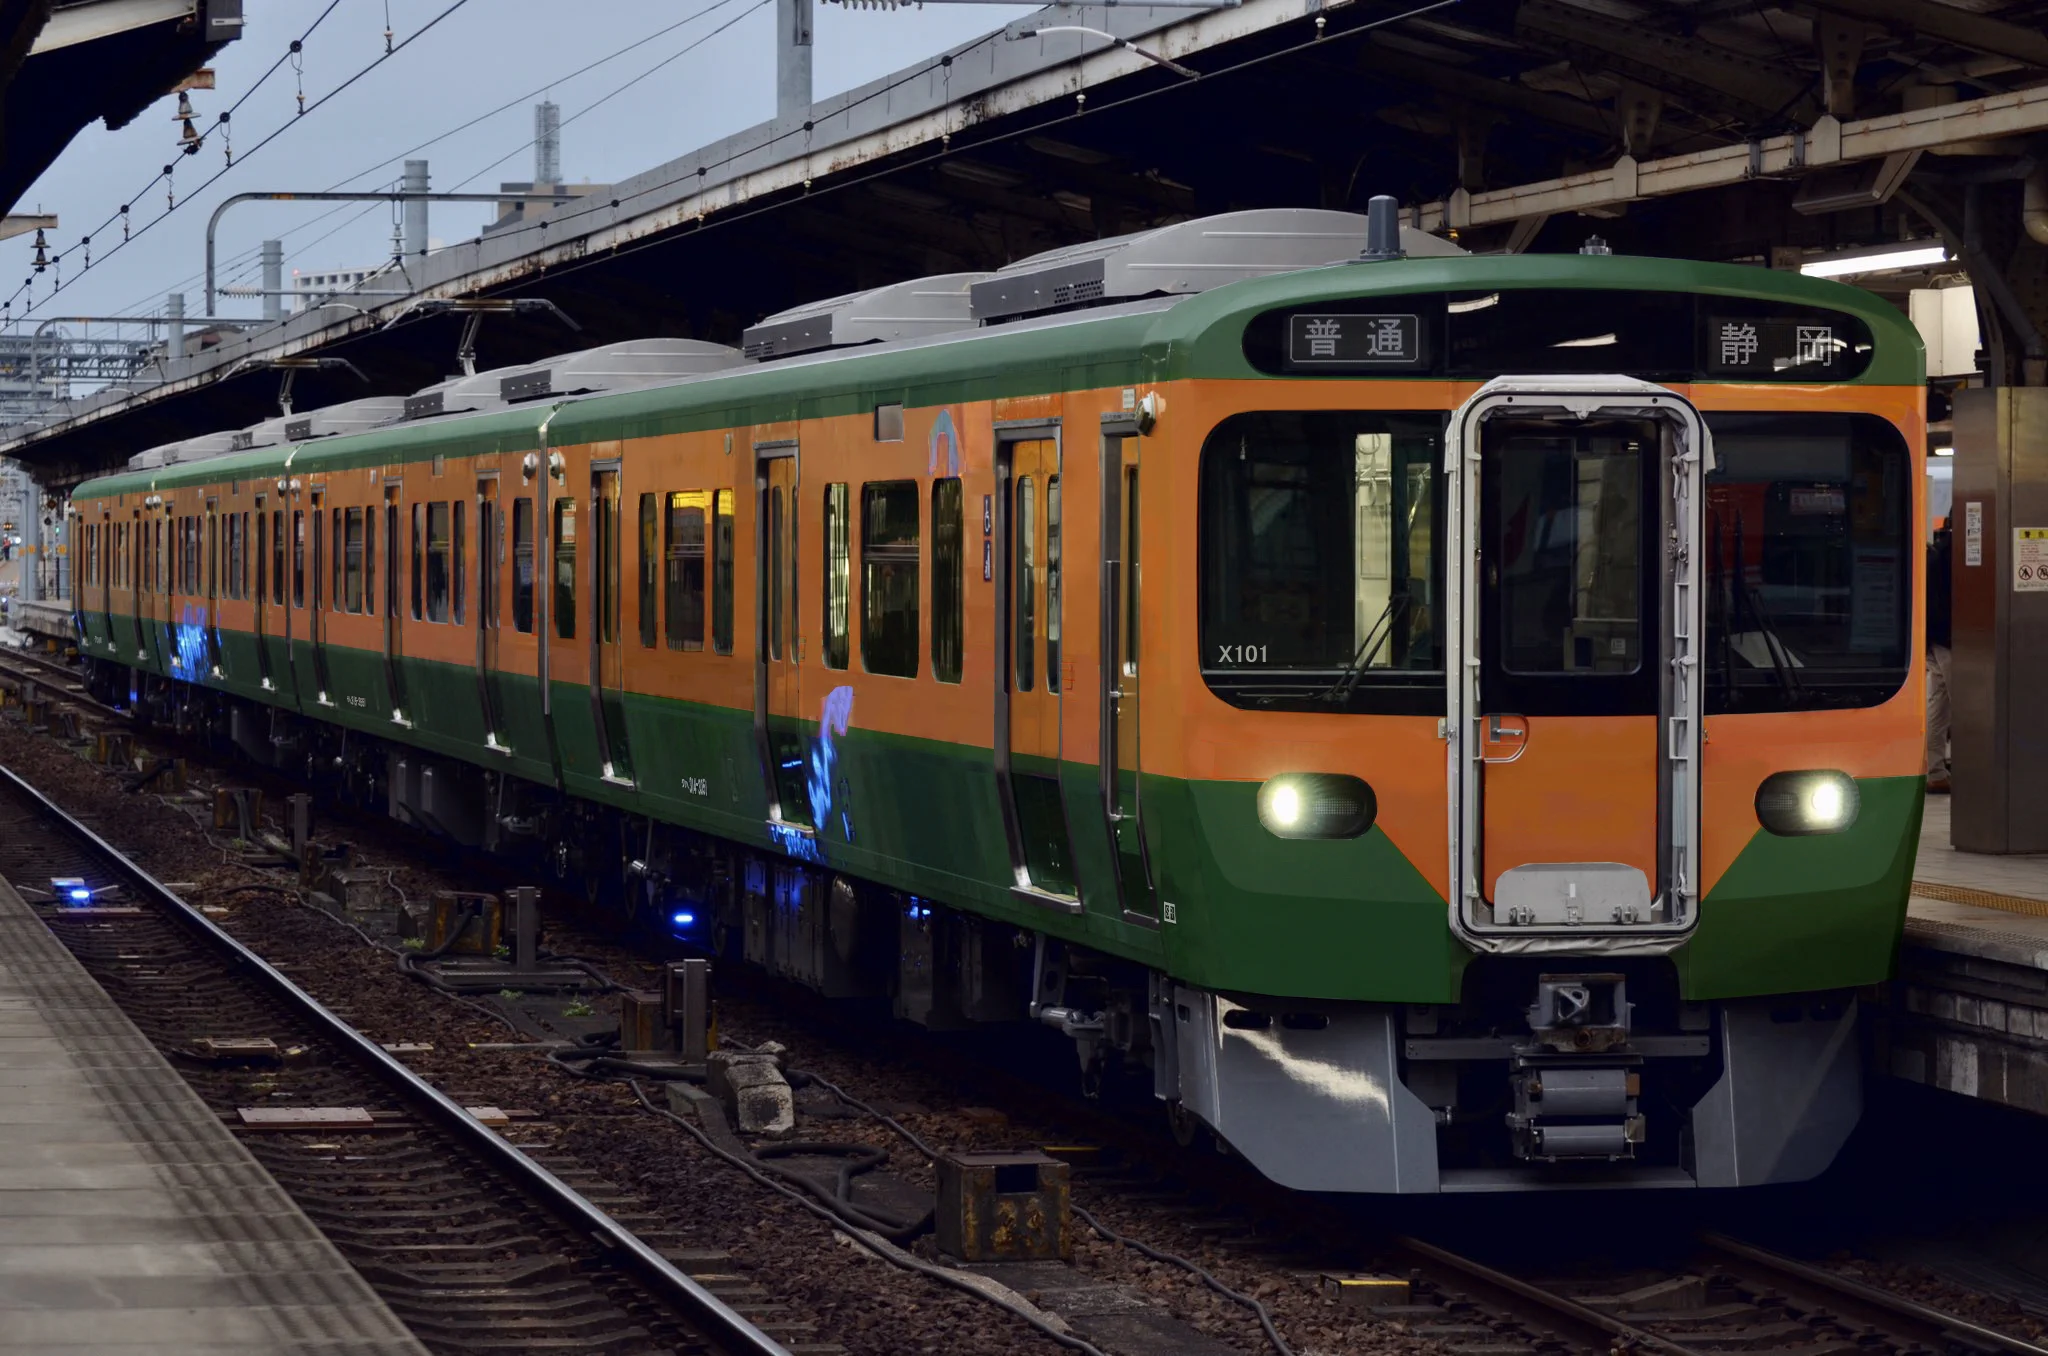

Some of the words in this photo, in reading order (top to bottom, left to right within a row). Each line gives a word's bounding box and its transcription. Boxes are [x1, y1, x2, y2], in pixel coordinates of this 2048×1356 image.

[1304, 319, 1404, 356] 普通
[1720, 323, 1832, 366] 静岡
[1218, 645, 1267, 663] X101
